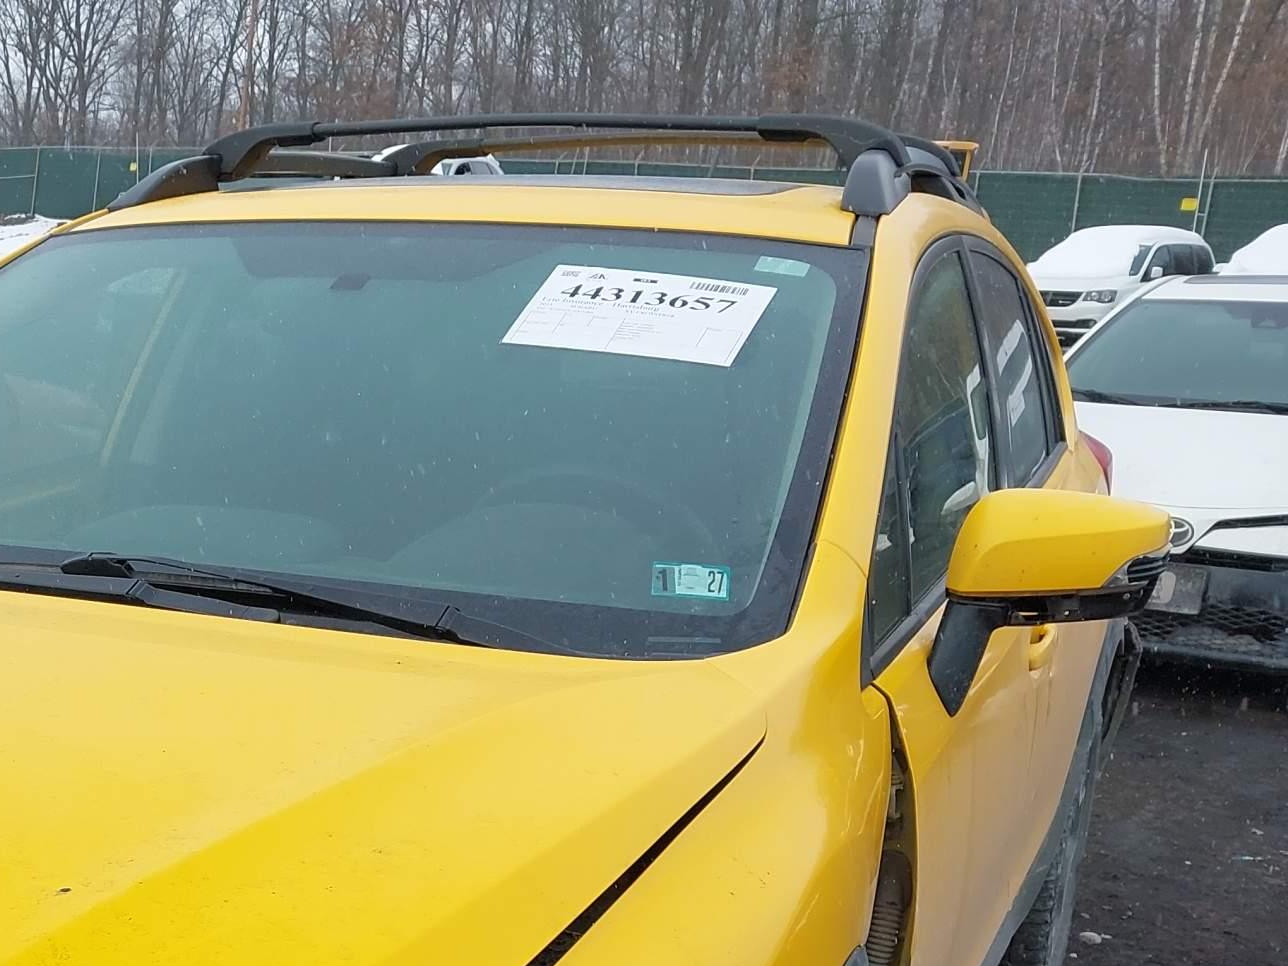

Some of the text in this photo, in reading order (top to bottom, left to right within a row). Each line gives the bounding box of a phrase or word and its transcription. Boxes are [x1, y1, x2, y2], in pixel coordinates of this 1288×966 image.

[561, 284, 738, 314] 44313657
[658, 568, 668, 592] 1
[707, 570, 725, 594] 27
